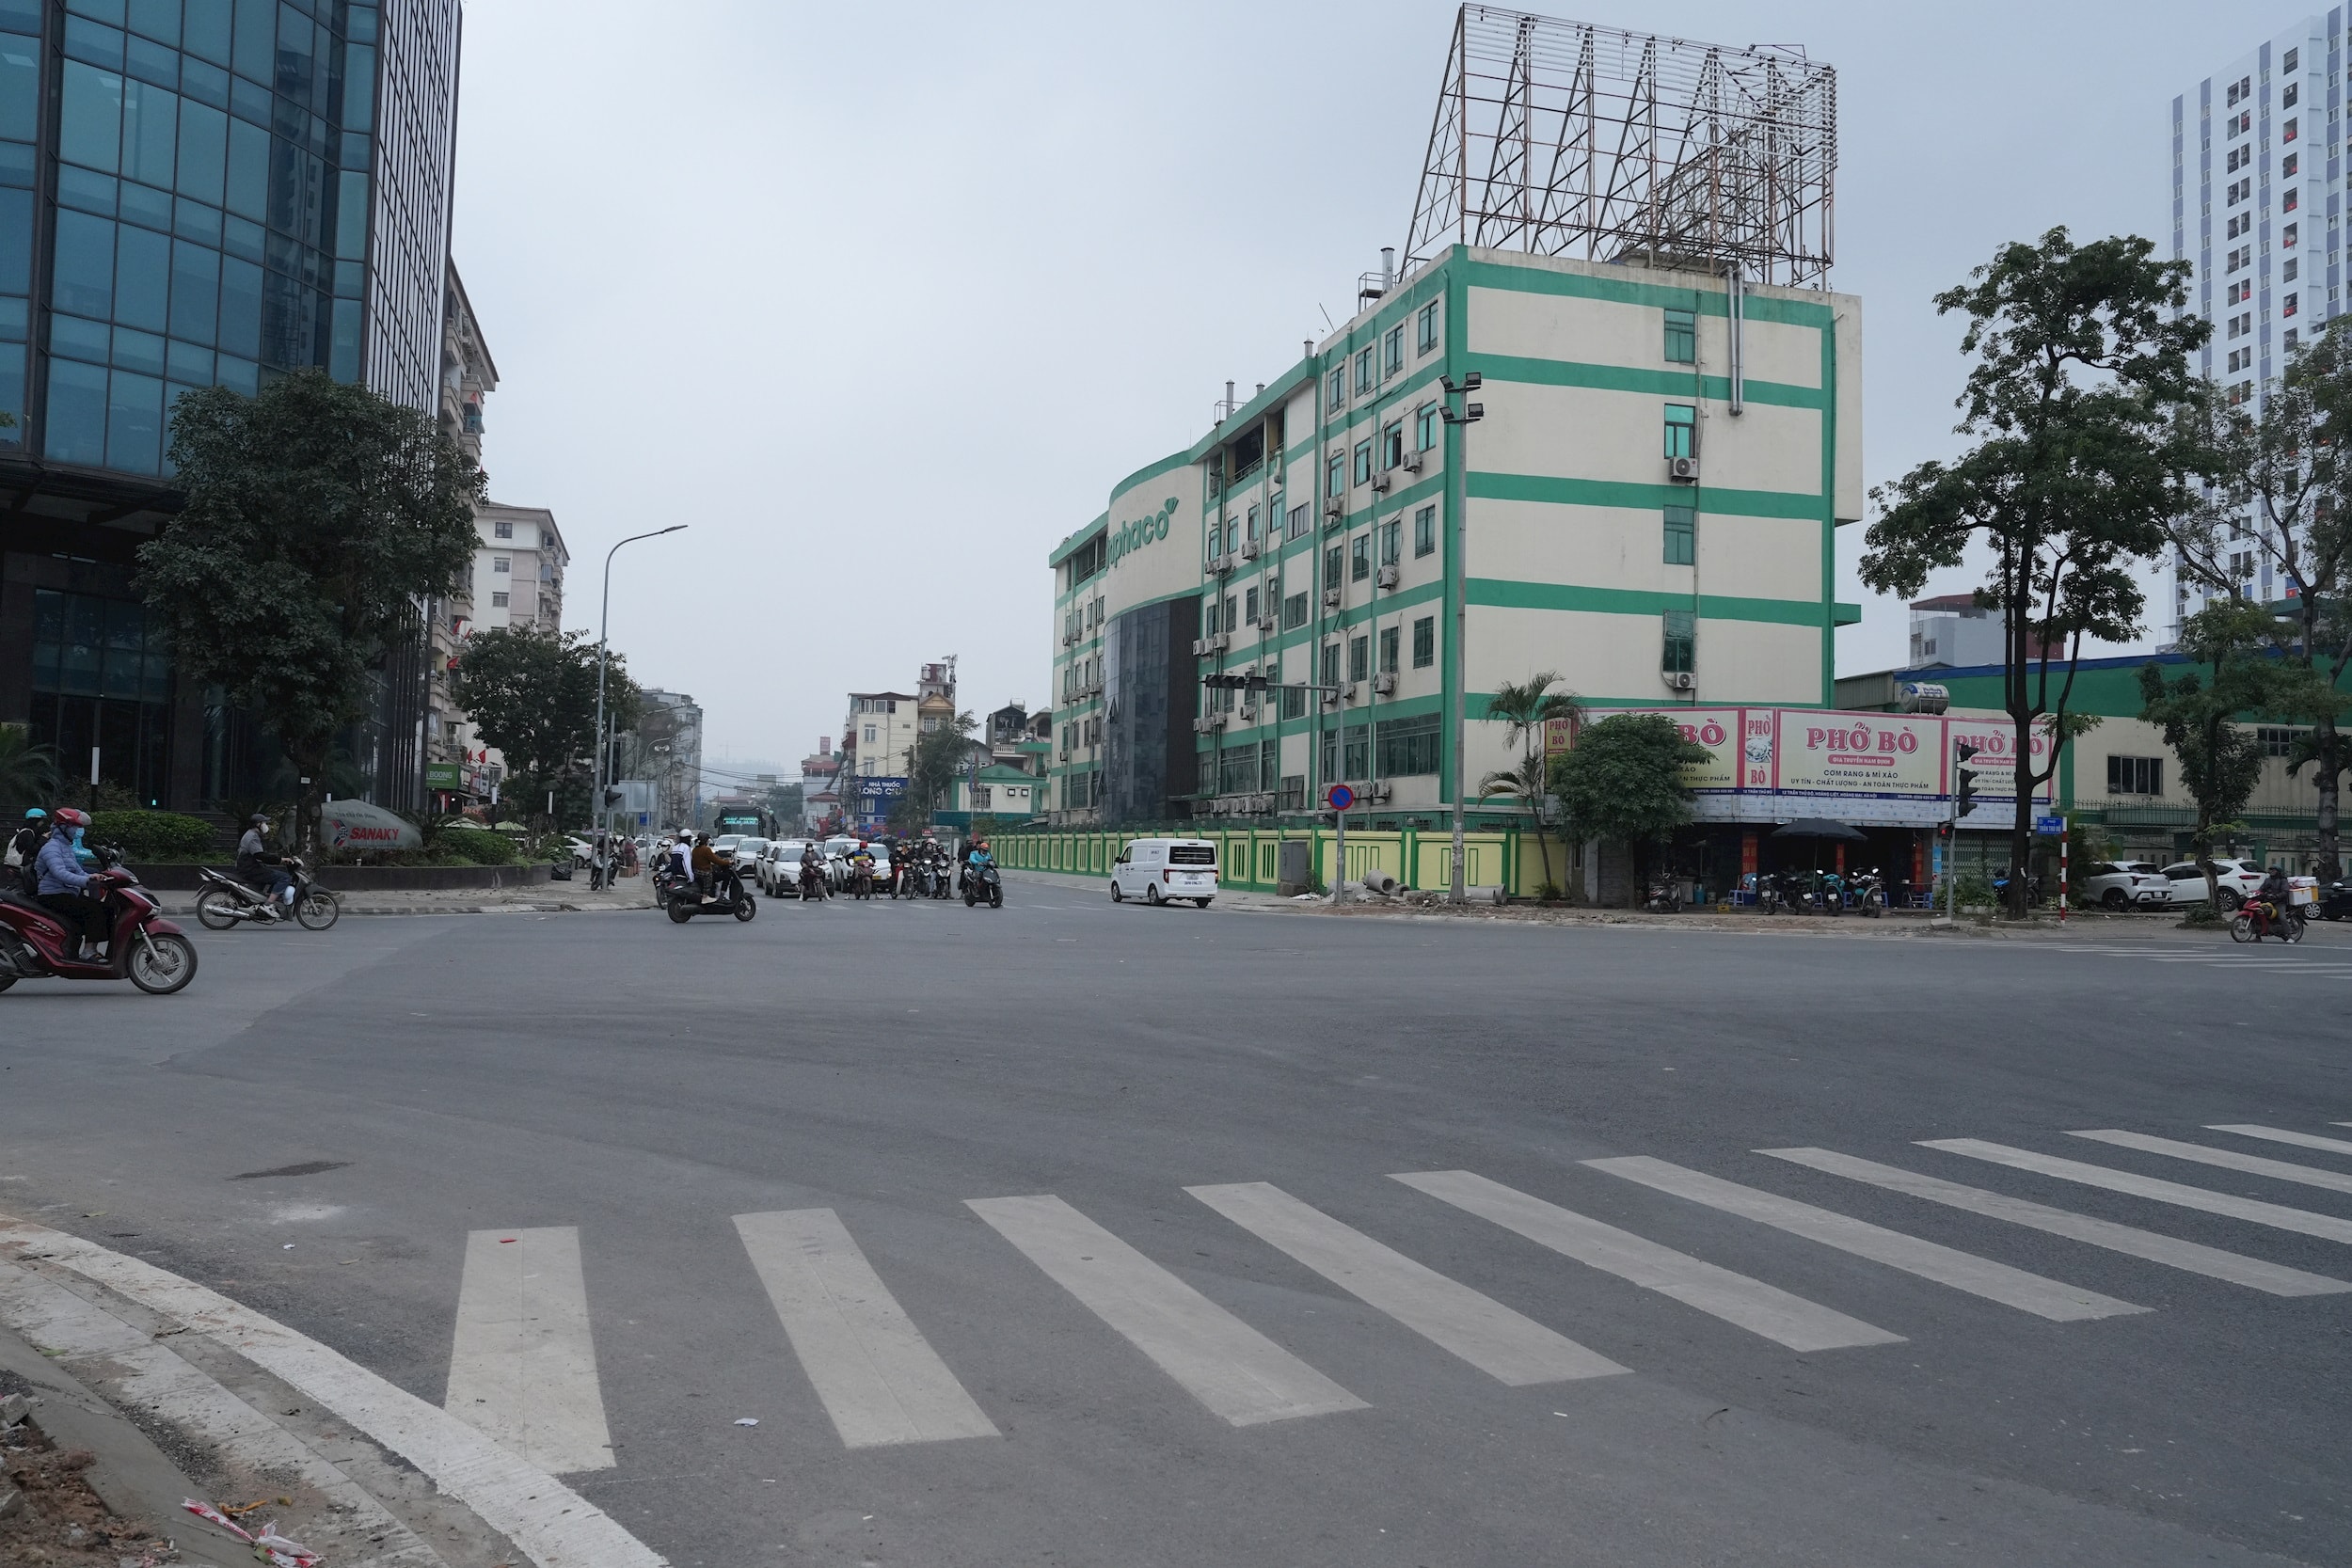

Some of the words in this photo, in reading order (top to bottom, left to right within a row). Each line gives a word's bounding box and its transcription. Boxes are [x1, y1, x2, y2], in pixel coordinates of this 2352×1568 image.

[1748, 714, 1772, 736] PHỞ
[1806, 721, 1871, 752] PHỞ
[1877, 726, 1918, 753] BÒ
[1750, 766, 1766, 784] BÒ
[1816, 778, 1834, 786] CHẤT
[1836, 780, 1858, 788] LƯỢNG
[1910, 780, 1930, 789] PHẨM
[349, 828, 399, 840] SANAKY
